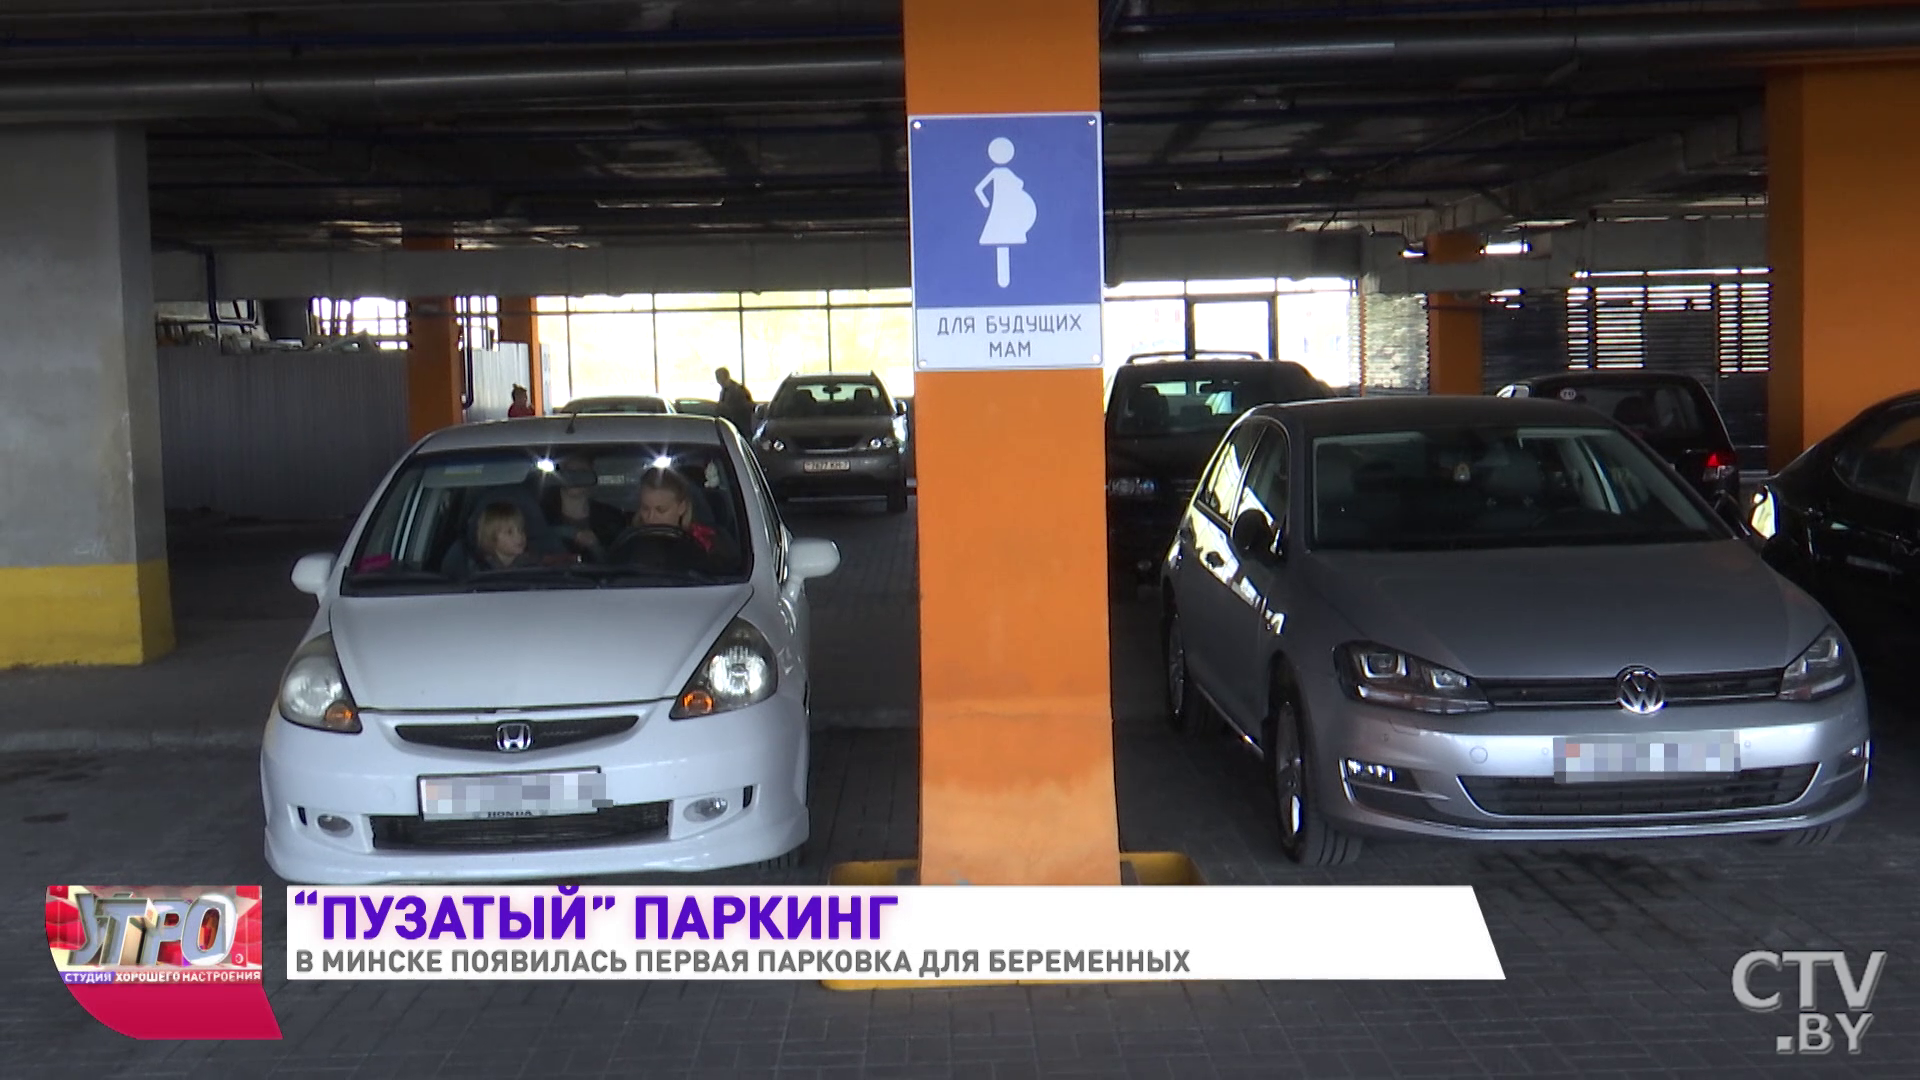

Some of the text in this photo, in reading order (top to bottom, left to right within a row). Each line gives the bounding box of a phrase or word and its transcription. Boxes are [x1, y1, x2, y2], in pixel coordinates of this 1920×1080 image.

[937, 313, 1082, 336] ДЛЯ БУДУЩИХ
[989, 340, 1031, 358] МАМ
